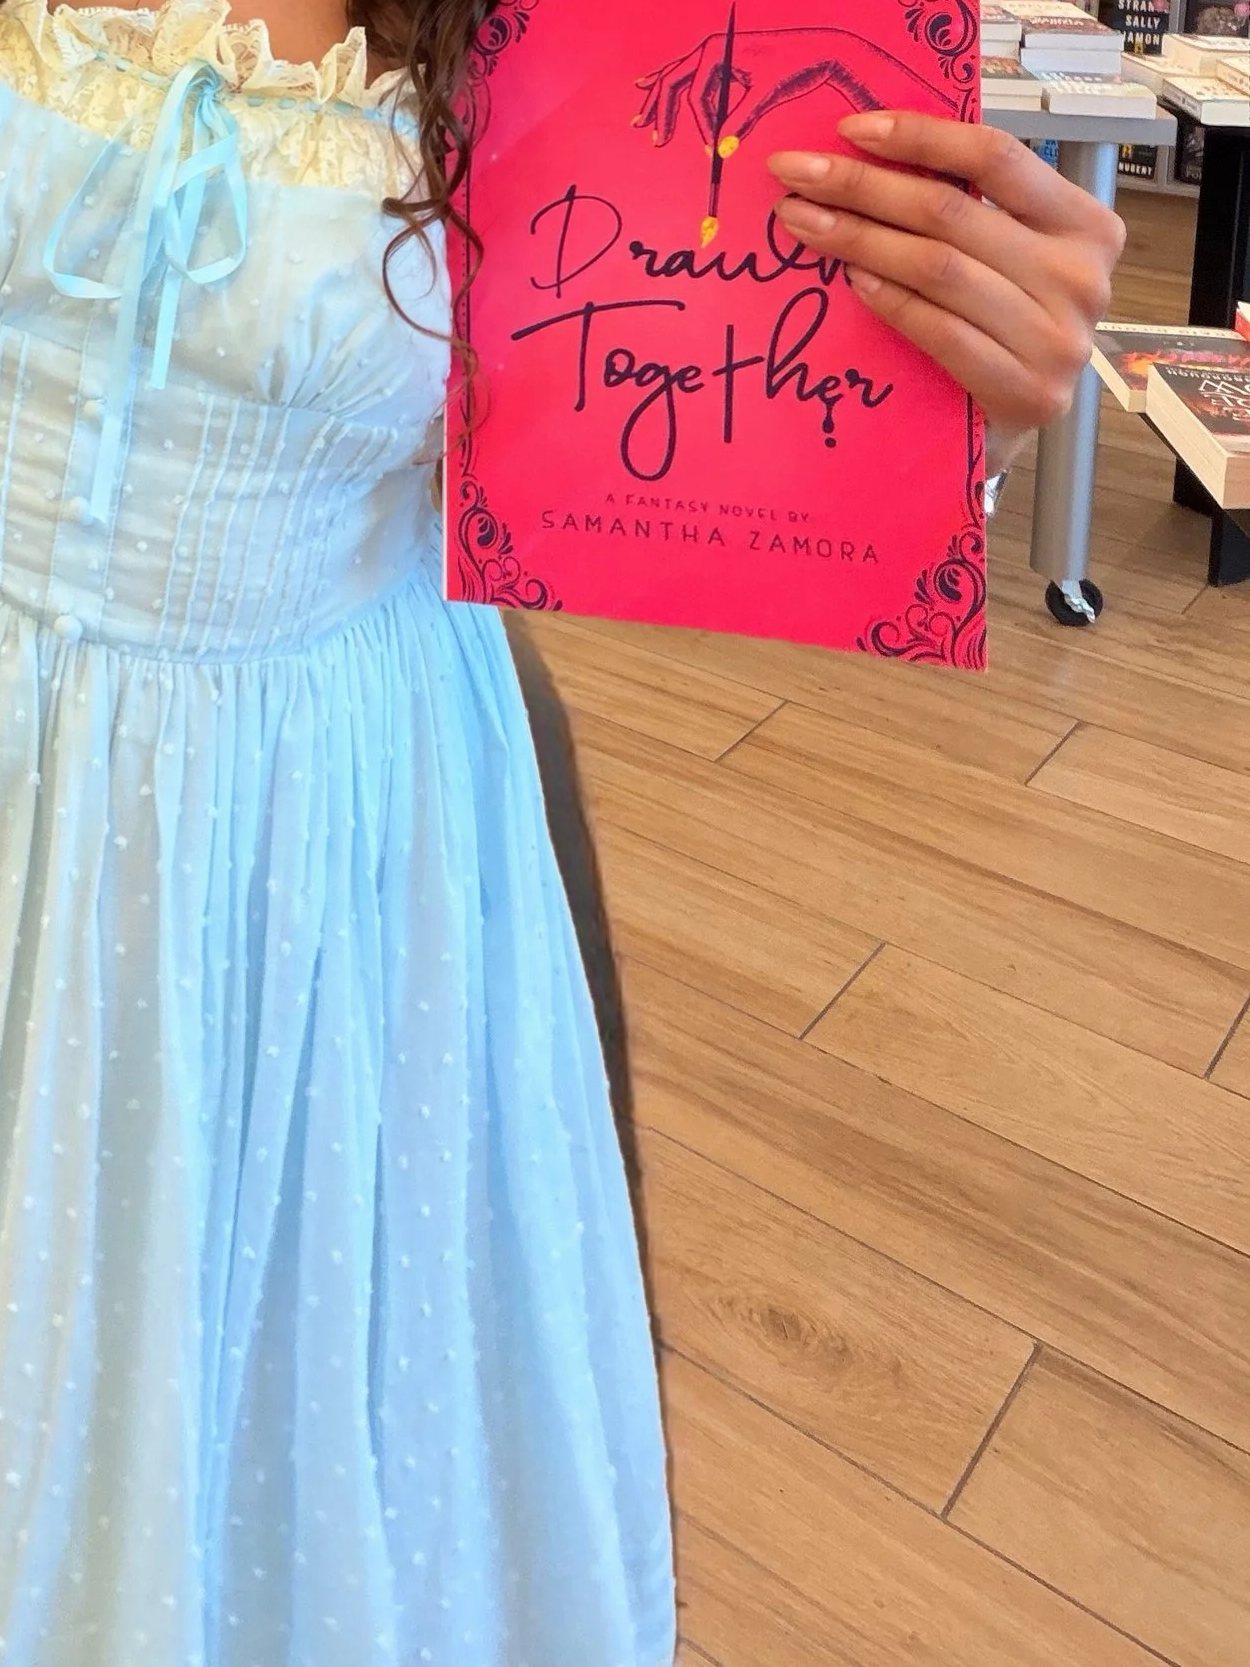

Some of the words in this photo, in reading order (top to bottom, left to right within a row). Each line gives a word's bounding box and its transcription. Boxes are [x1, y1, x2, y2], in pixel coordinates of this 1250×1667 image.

[1125, 14, 1161, 30] SALLY
[1118, 161, 1153, 176] NUGENT
[511, 286, 894, 482] Together
[606, 493, 616, 504] A
[626, 494, 710, 513] FANTASY
[719, 504, 779, 522] NOVEL
[788, 511, 809, 523] BY
[541, 509, 726, 547] SAMANTHA
[750, 530, 880, 564] ZAMORA
